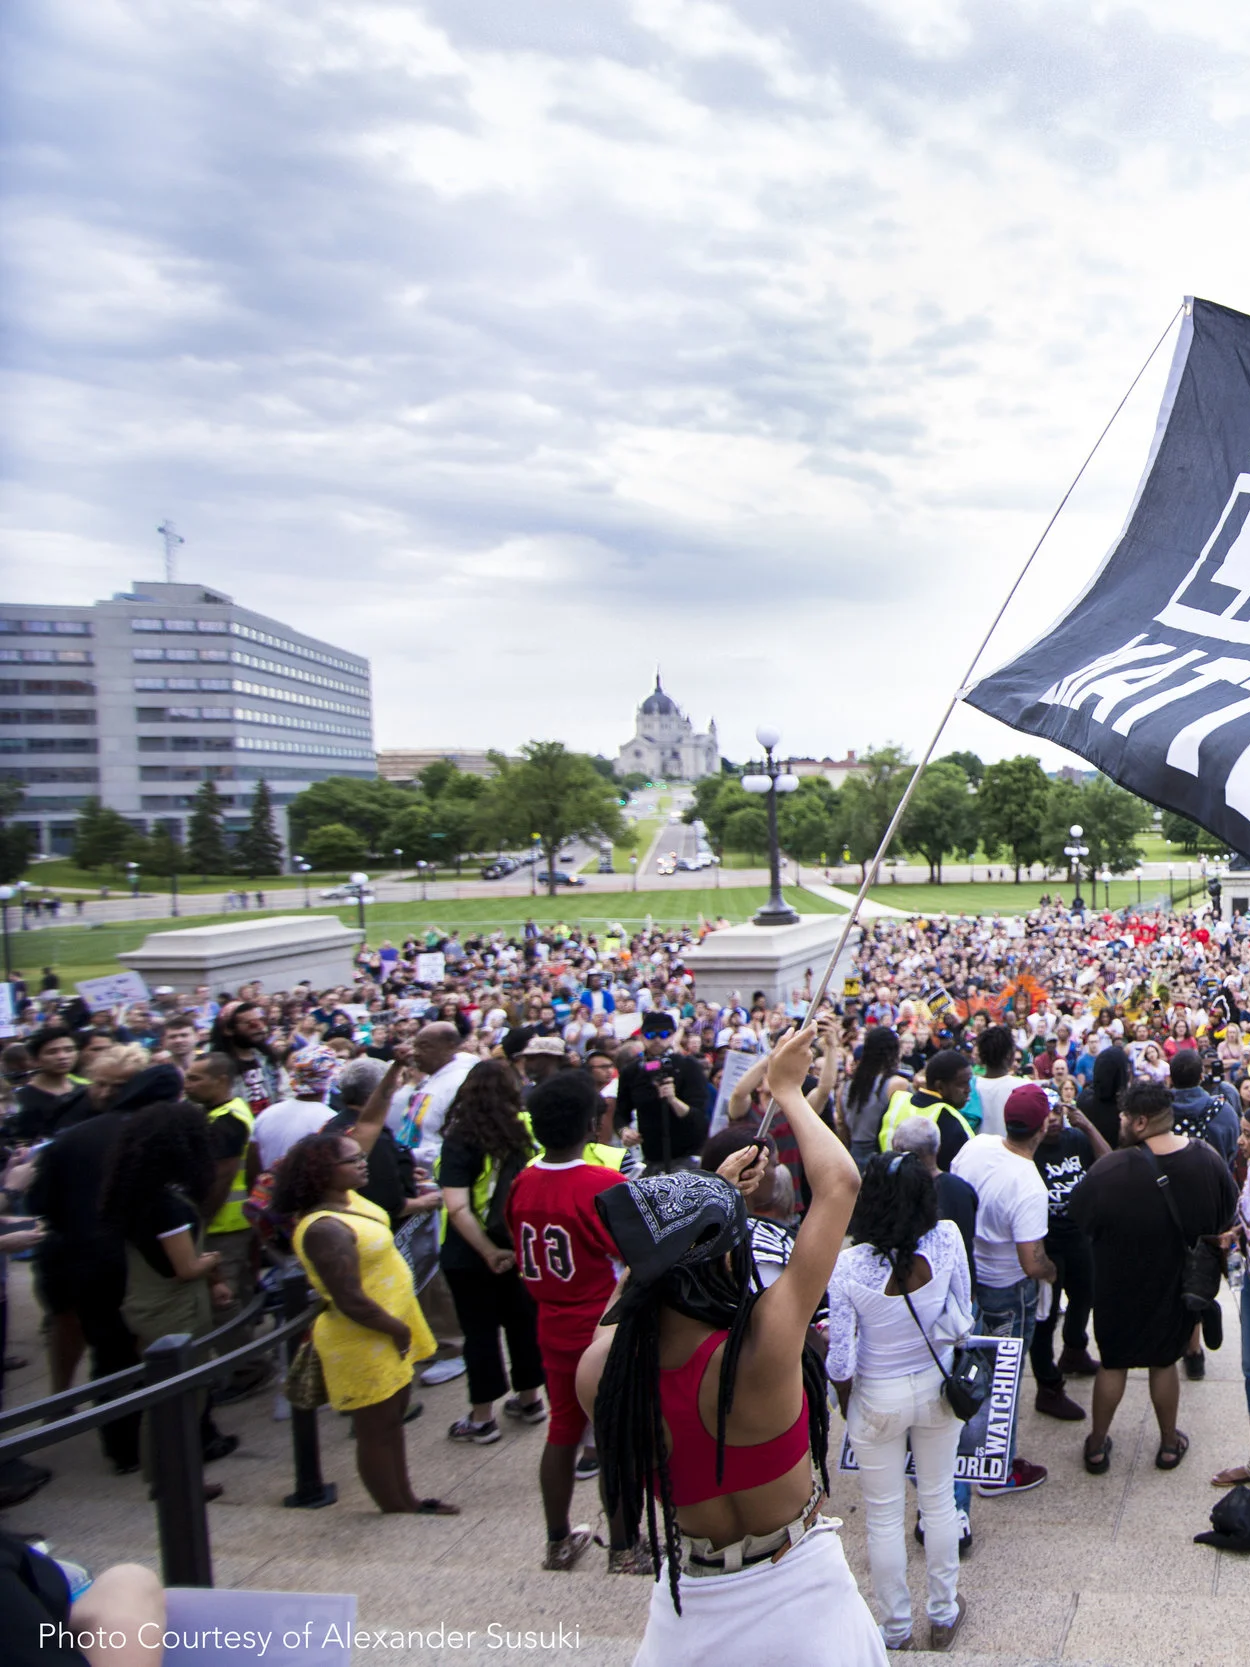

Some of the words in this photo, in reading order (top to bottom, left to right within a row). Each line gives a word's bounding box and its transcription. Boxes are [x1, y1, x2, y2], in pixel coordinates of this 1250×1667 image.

[984, 1340, 1020, 1457] WATCHING
[974, 1446, 986, 1457] IS
[953, 1456, 1003, 1478] ORLD
